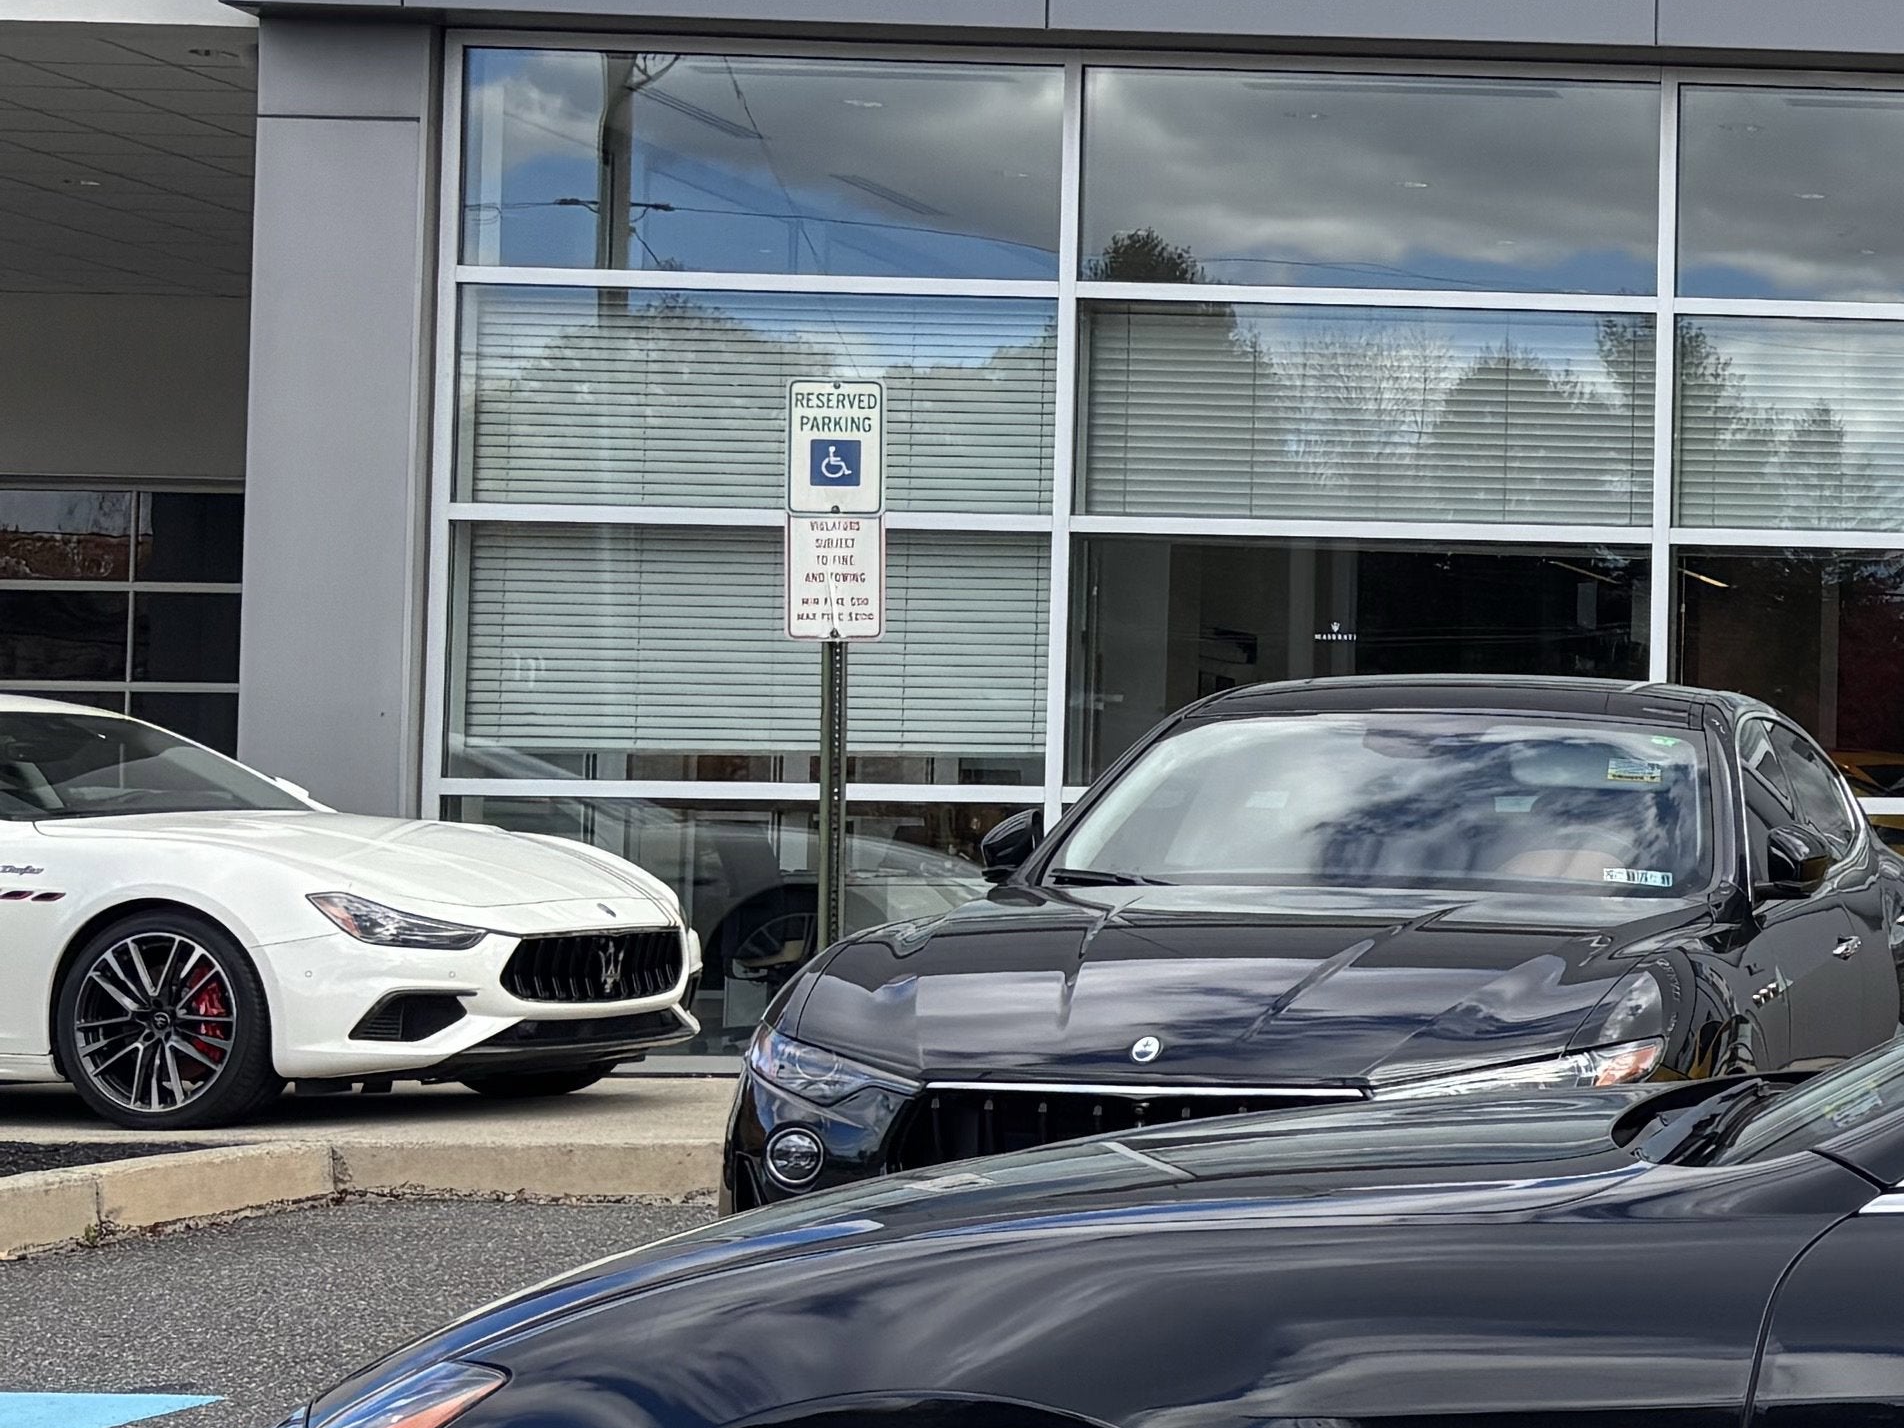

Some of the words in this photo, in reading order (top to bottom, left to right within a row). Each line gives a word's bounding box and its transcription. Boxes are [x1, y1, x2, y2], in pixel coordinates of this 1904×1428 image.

[794, 392, 878, 410] RESERVED
[800, 416, 872, 433] PARKING
[816, 555, 828, 566] TO
[805, 573, 825, 583] AND
